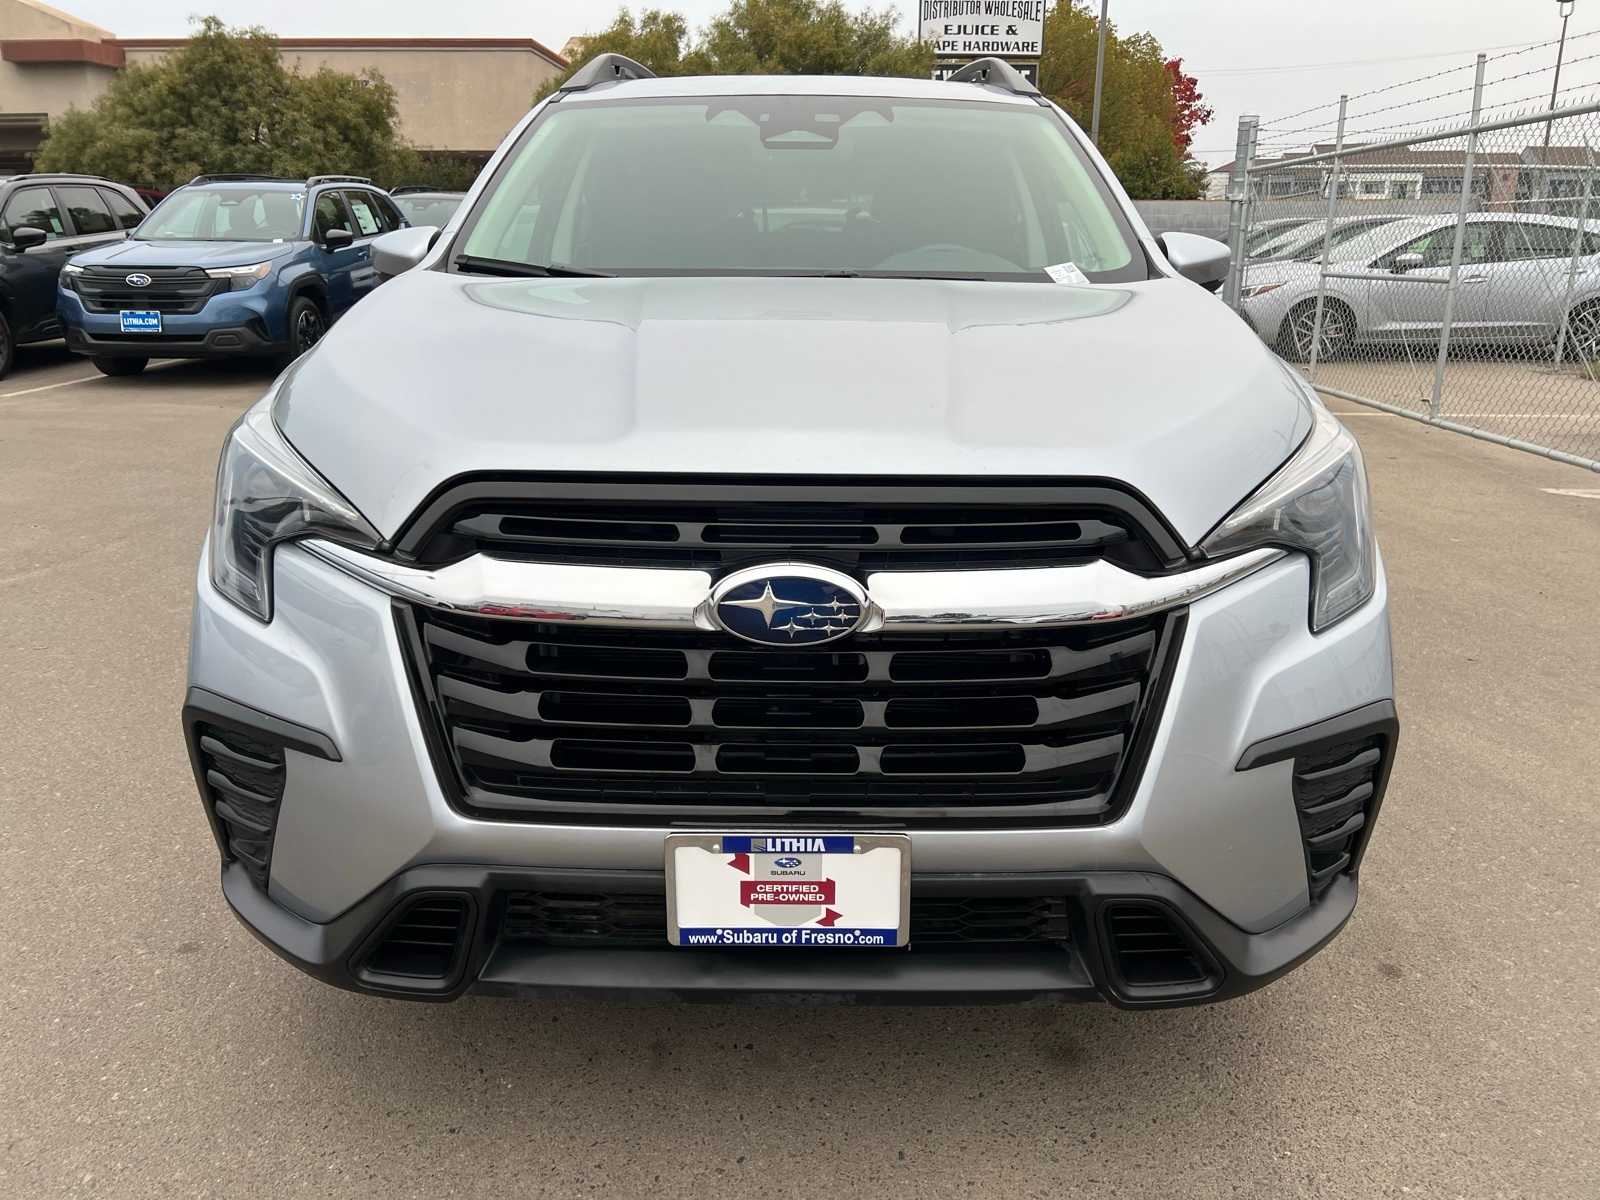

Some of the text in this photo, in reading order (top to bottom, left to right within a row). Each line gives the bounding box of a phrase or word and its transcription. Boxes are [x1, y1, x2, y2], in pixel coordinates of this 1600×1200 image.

[923, 0, 1042, 22] DISTRIBUTOR WHOLESALE
[944, 24, 1018, 35] EJUICE &
[931, 40, 1039, 52] APE HARDWARE
[124, 317, 158, 325] LITHIA.COM
[766, 838, 826, 852] LITHIA
[756, 884, 819, 893] CERTIFIED
[750, 893, 825, 902] PRE-OWNED
[688, 929, 884, 945] www.Subaru of Fresno.com
